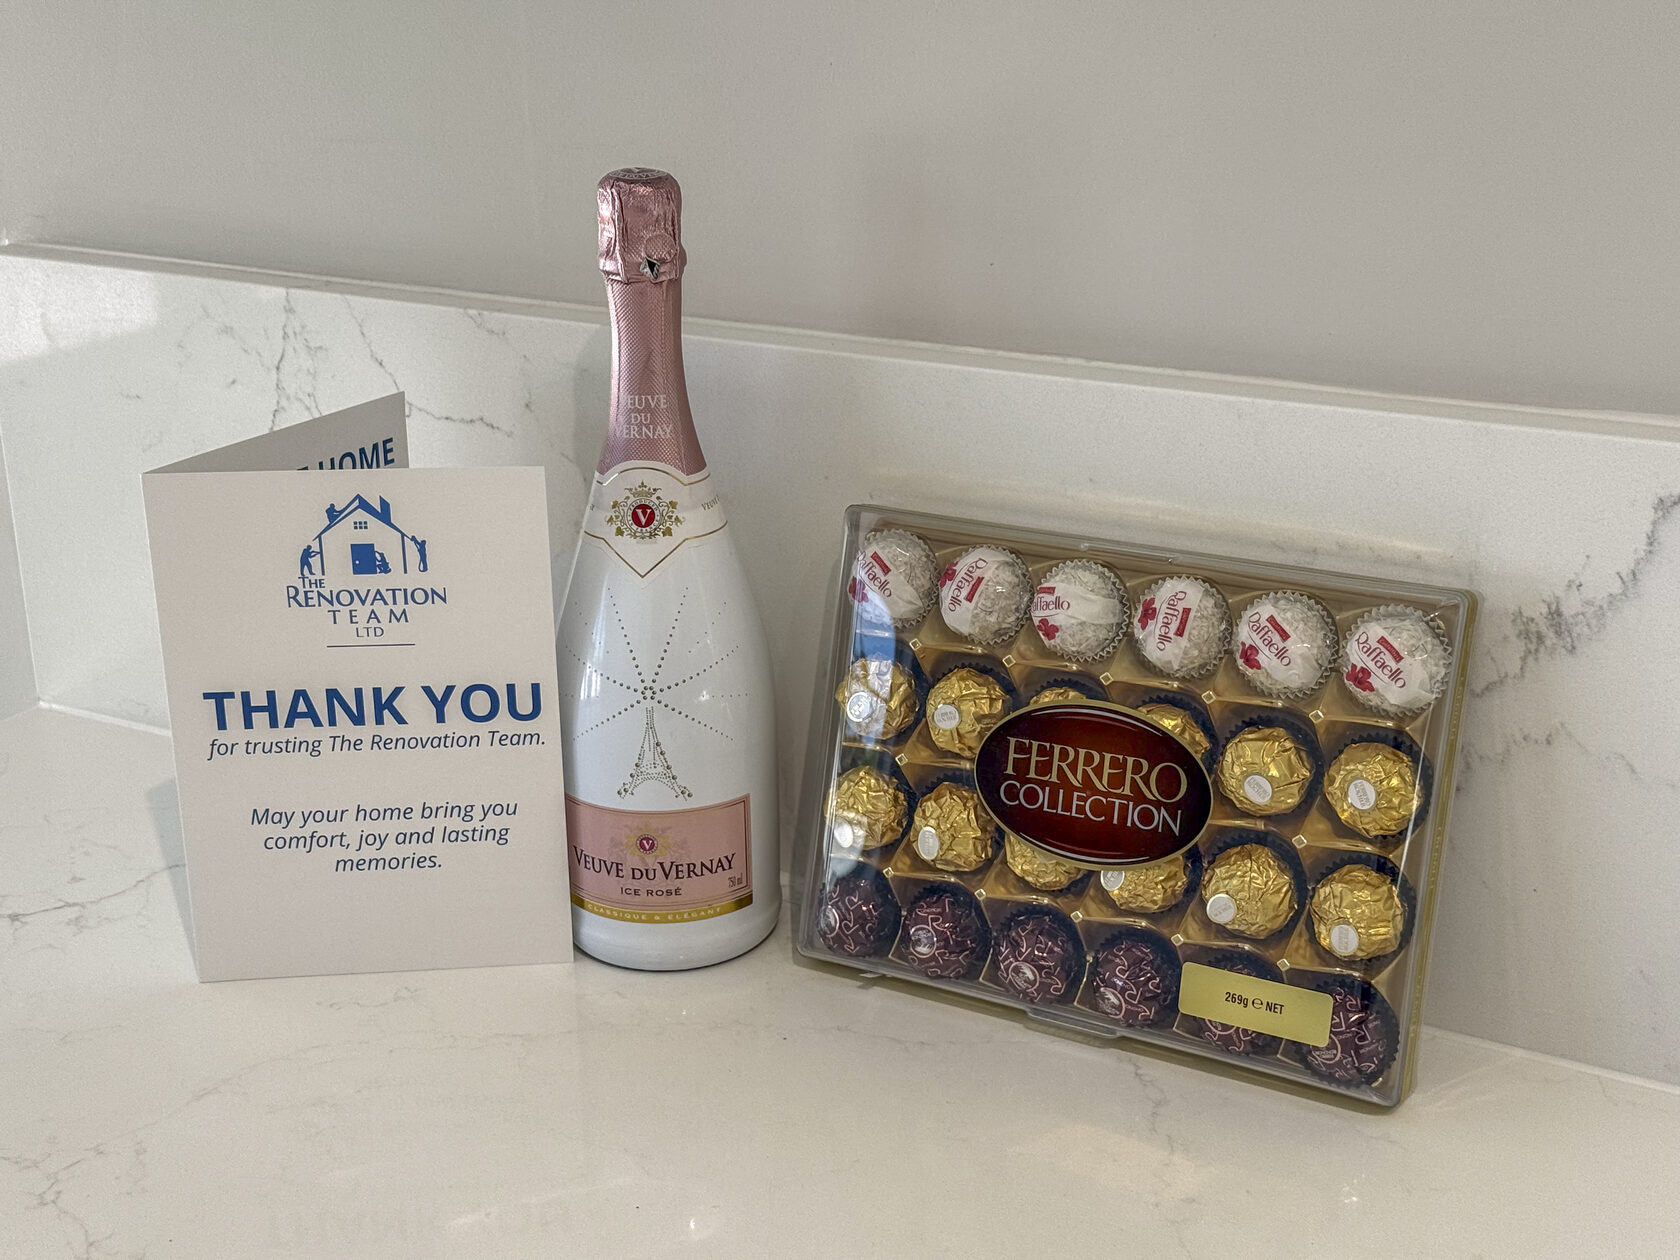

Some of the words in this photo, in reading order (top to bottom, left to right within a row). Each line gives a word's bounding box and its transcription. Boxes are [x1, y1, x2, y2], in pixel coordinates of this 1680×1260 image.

[627, 395, 668, 409] EUVE
[631, 413, 651, 424] DU
[635, 508, 652, 526] V
[298, 576, 326, 589] THE
[949, 557, 988, 612] Raffaello
[286, 586, 448, 609] RENOVATION
[1031, 595, 1071, 612] affaello
[327, 609, 410, 625] TEAM
[1156, 590, 1187, 652] Raffaello
[355, 626, 385, 638] LTD
[1248, 611, 1291, 667] Raffaello
[1355, 631, 1406, 689] Raffaello
[203, 686, 409, 731] THANK
[420, 683, 543, 724] YOU
[207, 738, 239, 761] for
[244, 736, 323, 757] trusting
[329, 735, 363, 752] The
[370, 731, 481, 751] Renovation
[487, 730, 546, 747] Team.
[1003, 736, 1188, 803] FERRERO
[251, 807, 296, 829] May
[299, 807, 349, 828] your
[355, 804, 414, 823] home
[420, 801, 476, 821] bring
[481, 801, 518, 821] you
[1000, 780, 1182, 836] COLLECTION
[264, 830, 351, 853] comfort,
[356, 830, 389, 851] joy
[395, 827, 435, 845] and
[442, 824, 511, 845] lasting
[335, 853, 442, 872] memories.
[573, 845, 625, 879] VEUVE
[631, 867, 656, 881] DU
[657, 852, 736, 882] VERNAY
[620, 886, 641, 896] ICE
[646, 886, 682, 897] ROSÉ
[587, 904, 647, 920] CLASSIQUE
[1225, 991, 1249, 1009] 269g
[1265, 1001, 1284, 1015] NET
